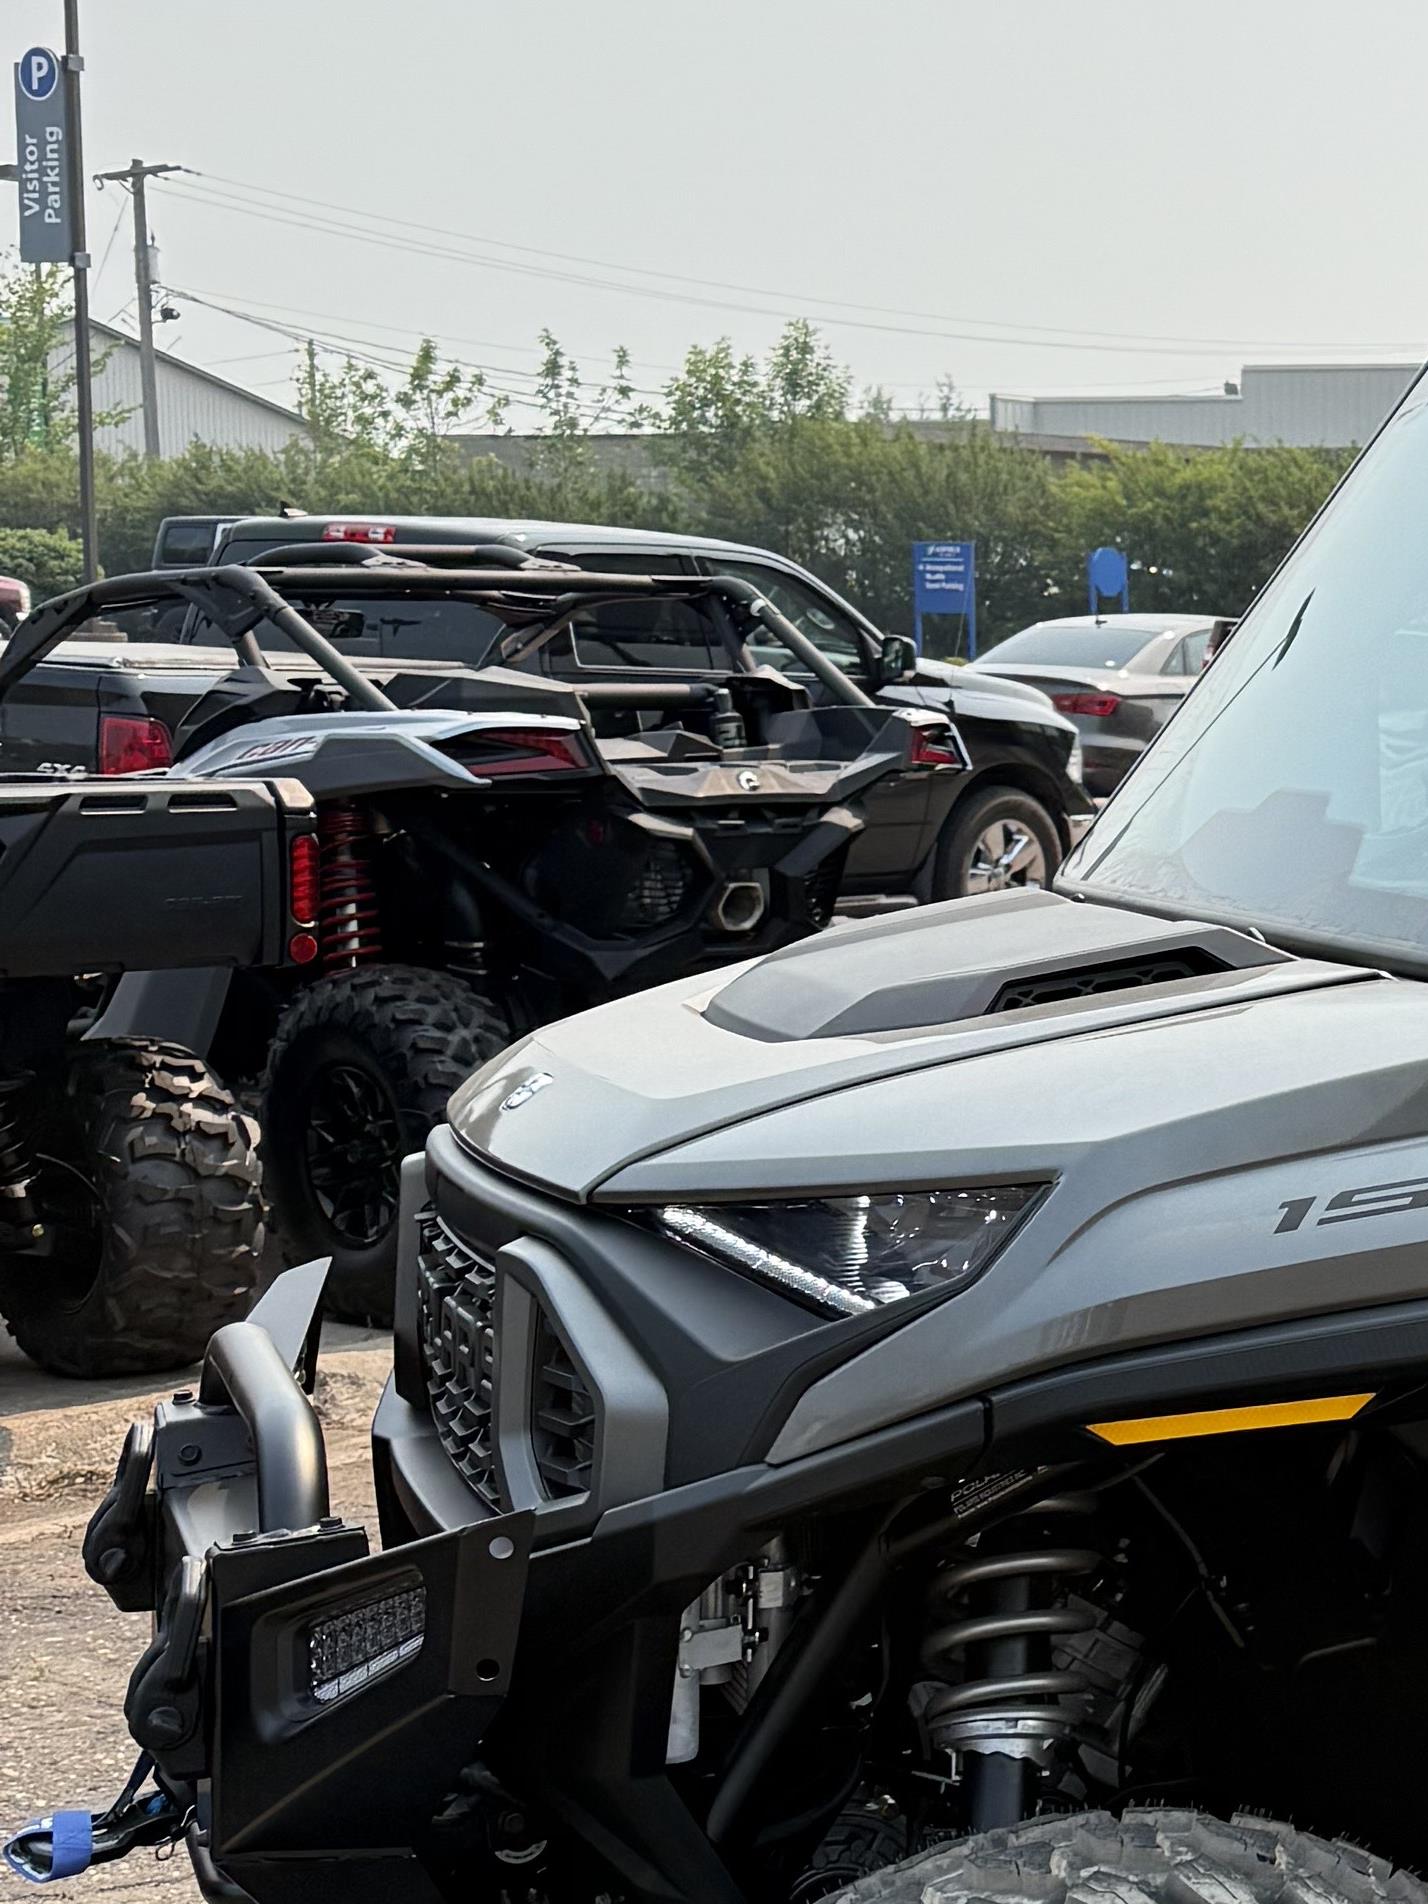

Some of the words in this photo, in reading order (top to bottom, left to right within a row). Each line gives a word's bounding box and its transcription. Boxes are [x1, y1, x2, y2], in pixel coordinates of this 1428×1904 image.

[30, 55, 49, 90] P
[23, 134, 38, 217] Visitor
[42, 126, 63, 224] Parking
